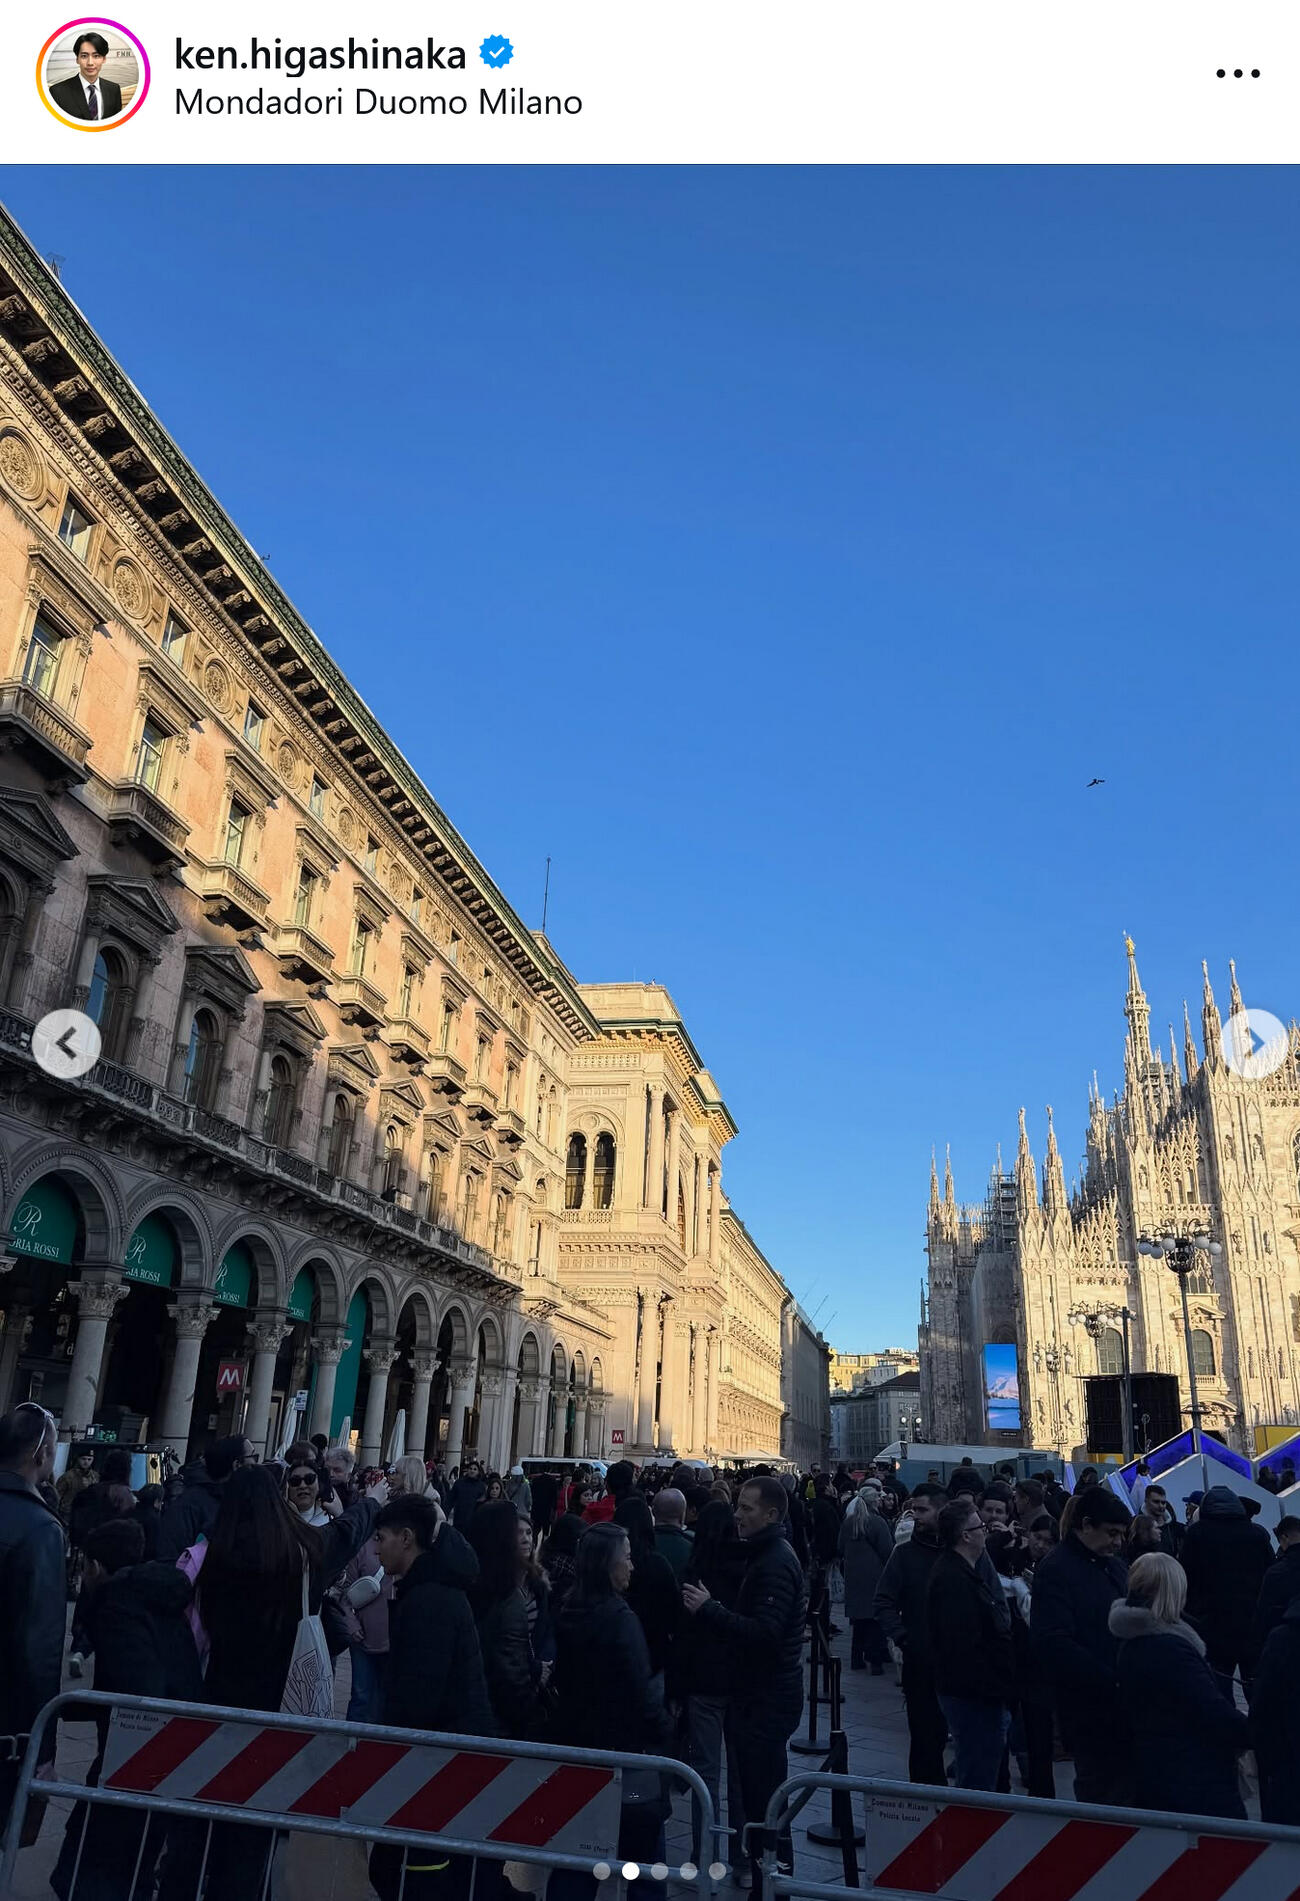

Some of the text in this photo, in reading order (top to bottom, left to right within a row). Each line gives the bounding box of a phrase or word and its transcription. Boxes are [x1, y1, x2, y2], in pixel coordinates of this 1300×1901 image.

[33, 1242, 59, 1258] ROSSI
[140, 1268, 160, 1283] ROSSI
[219, 1368, 240, 1386] M
[908, 1802, 929, 1812] Milano
